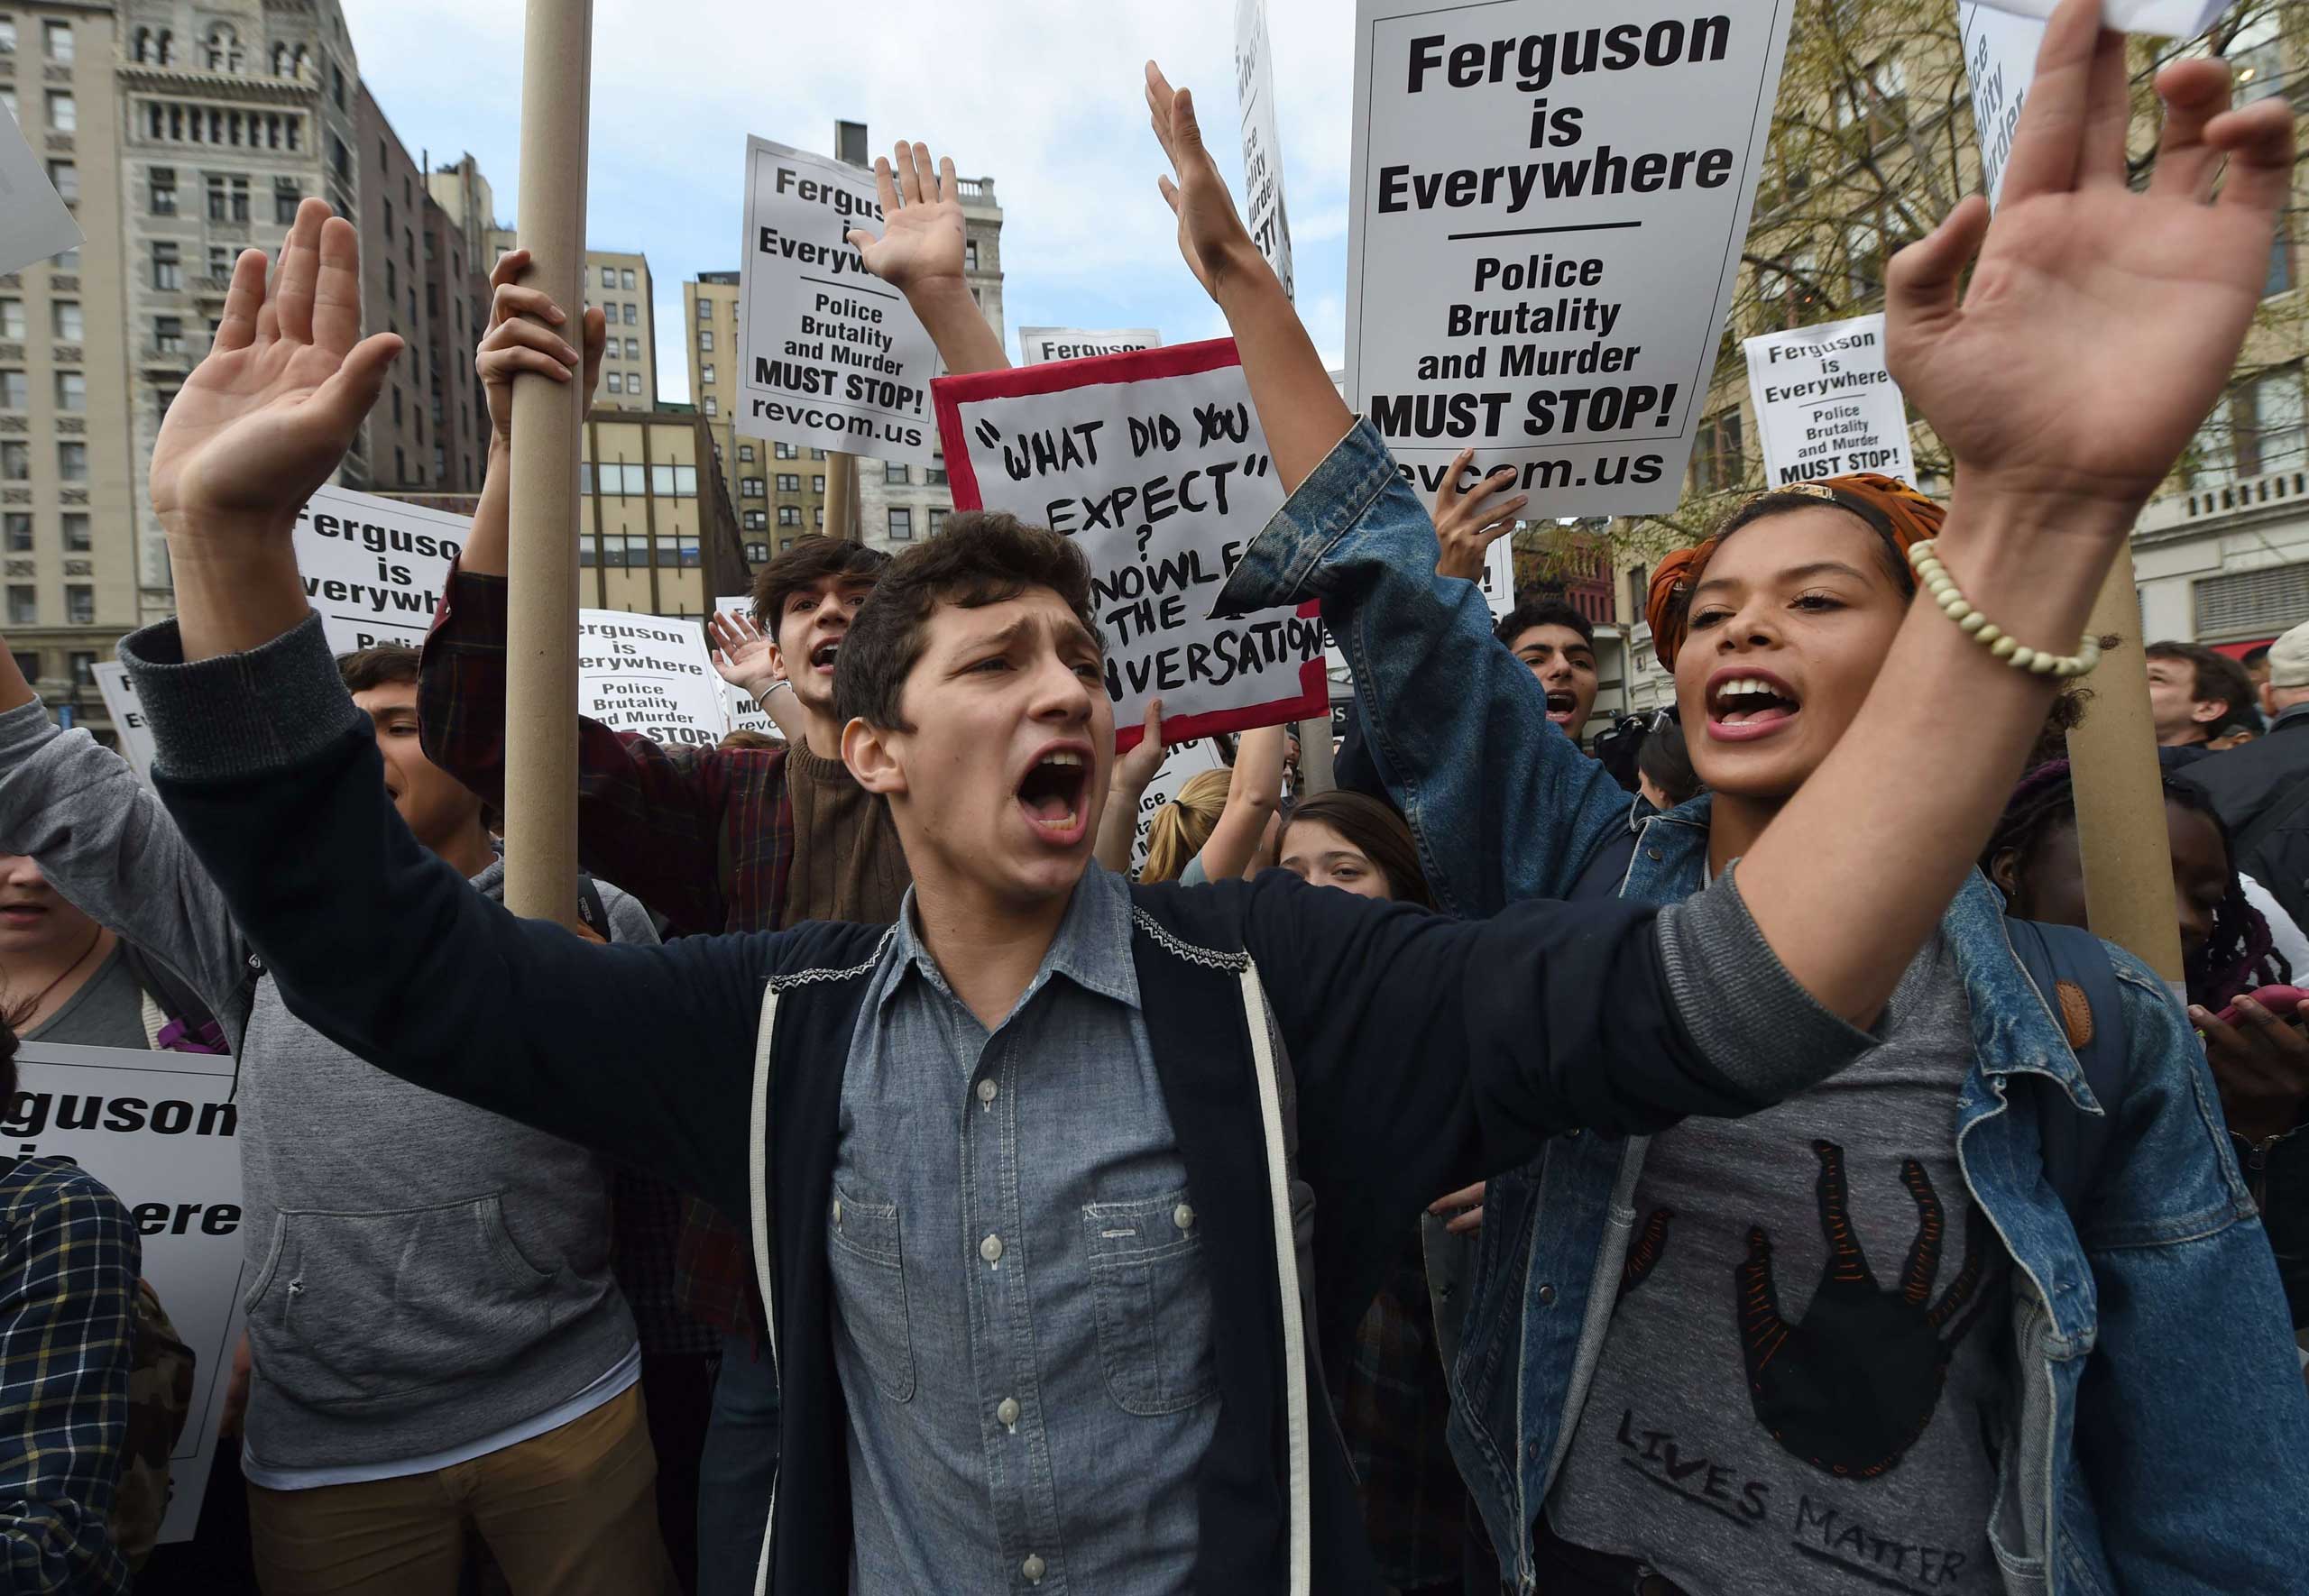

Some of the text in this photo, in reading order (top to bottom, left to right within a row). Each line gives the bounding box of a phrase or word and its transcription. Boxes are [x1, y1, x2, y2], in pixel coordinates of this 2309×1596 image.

[1407, 14, 1731, 94] Ferguson
[1530, 98, 1584, 149] is
[1378, 145, 1733, 214] Everywhere
[1475, 254, 1603, 292] Police
[815, 293, 883, 324] Police
[1448, 298, 1622, 337] Brutality
[801, 316, 893, 353] Brutality
[1042, 342, 1146, 360] Fergus
[1769, 333, 1875, 363] Ferguson
[785, 340, 904, 376] and Murder
[1417, 343, 1641, 381] and Murder
[1821, 359, 1840, 374] is
[755, 357, 924, 415] MUST STOP!
[1766, 370, 1888, 403] Everywhere
[752, 398, 922, 446] revcom.us
[1371, 383, 1679, 438] MUST STOP!
[1813, 406, 1860, 423] Police
[1127, 413, 1182, 457] DID
[1192, 402, 1249, 447] YOU
[1798, 434, 1879, 458] and Murder
[1807, 419, 1869, 440] Brutality
[1780, 447, 1900, 485] MUST STOP!
[377, 556, 412, 585] is
[1105, 594, 1186, 647] THE
[612, 640, 637, 655] is
[593, 698, 677, 711] Brutality
[603, 683, 664, 694] Police
[626, 711, 695, 724] Murder
[1616, 1408, 1967, 1588] LIVES MATTER
